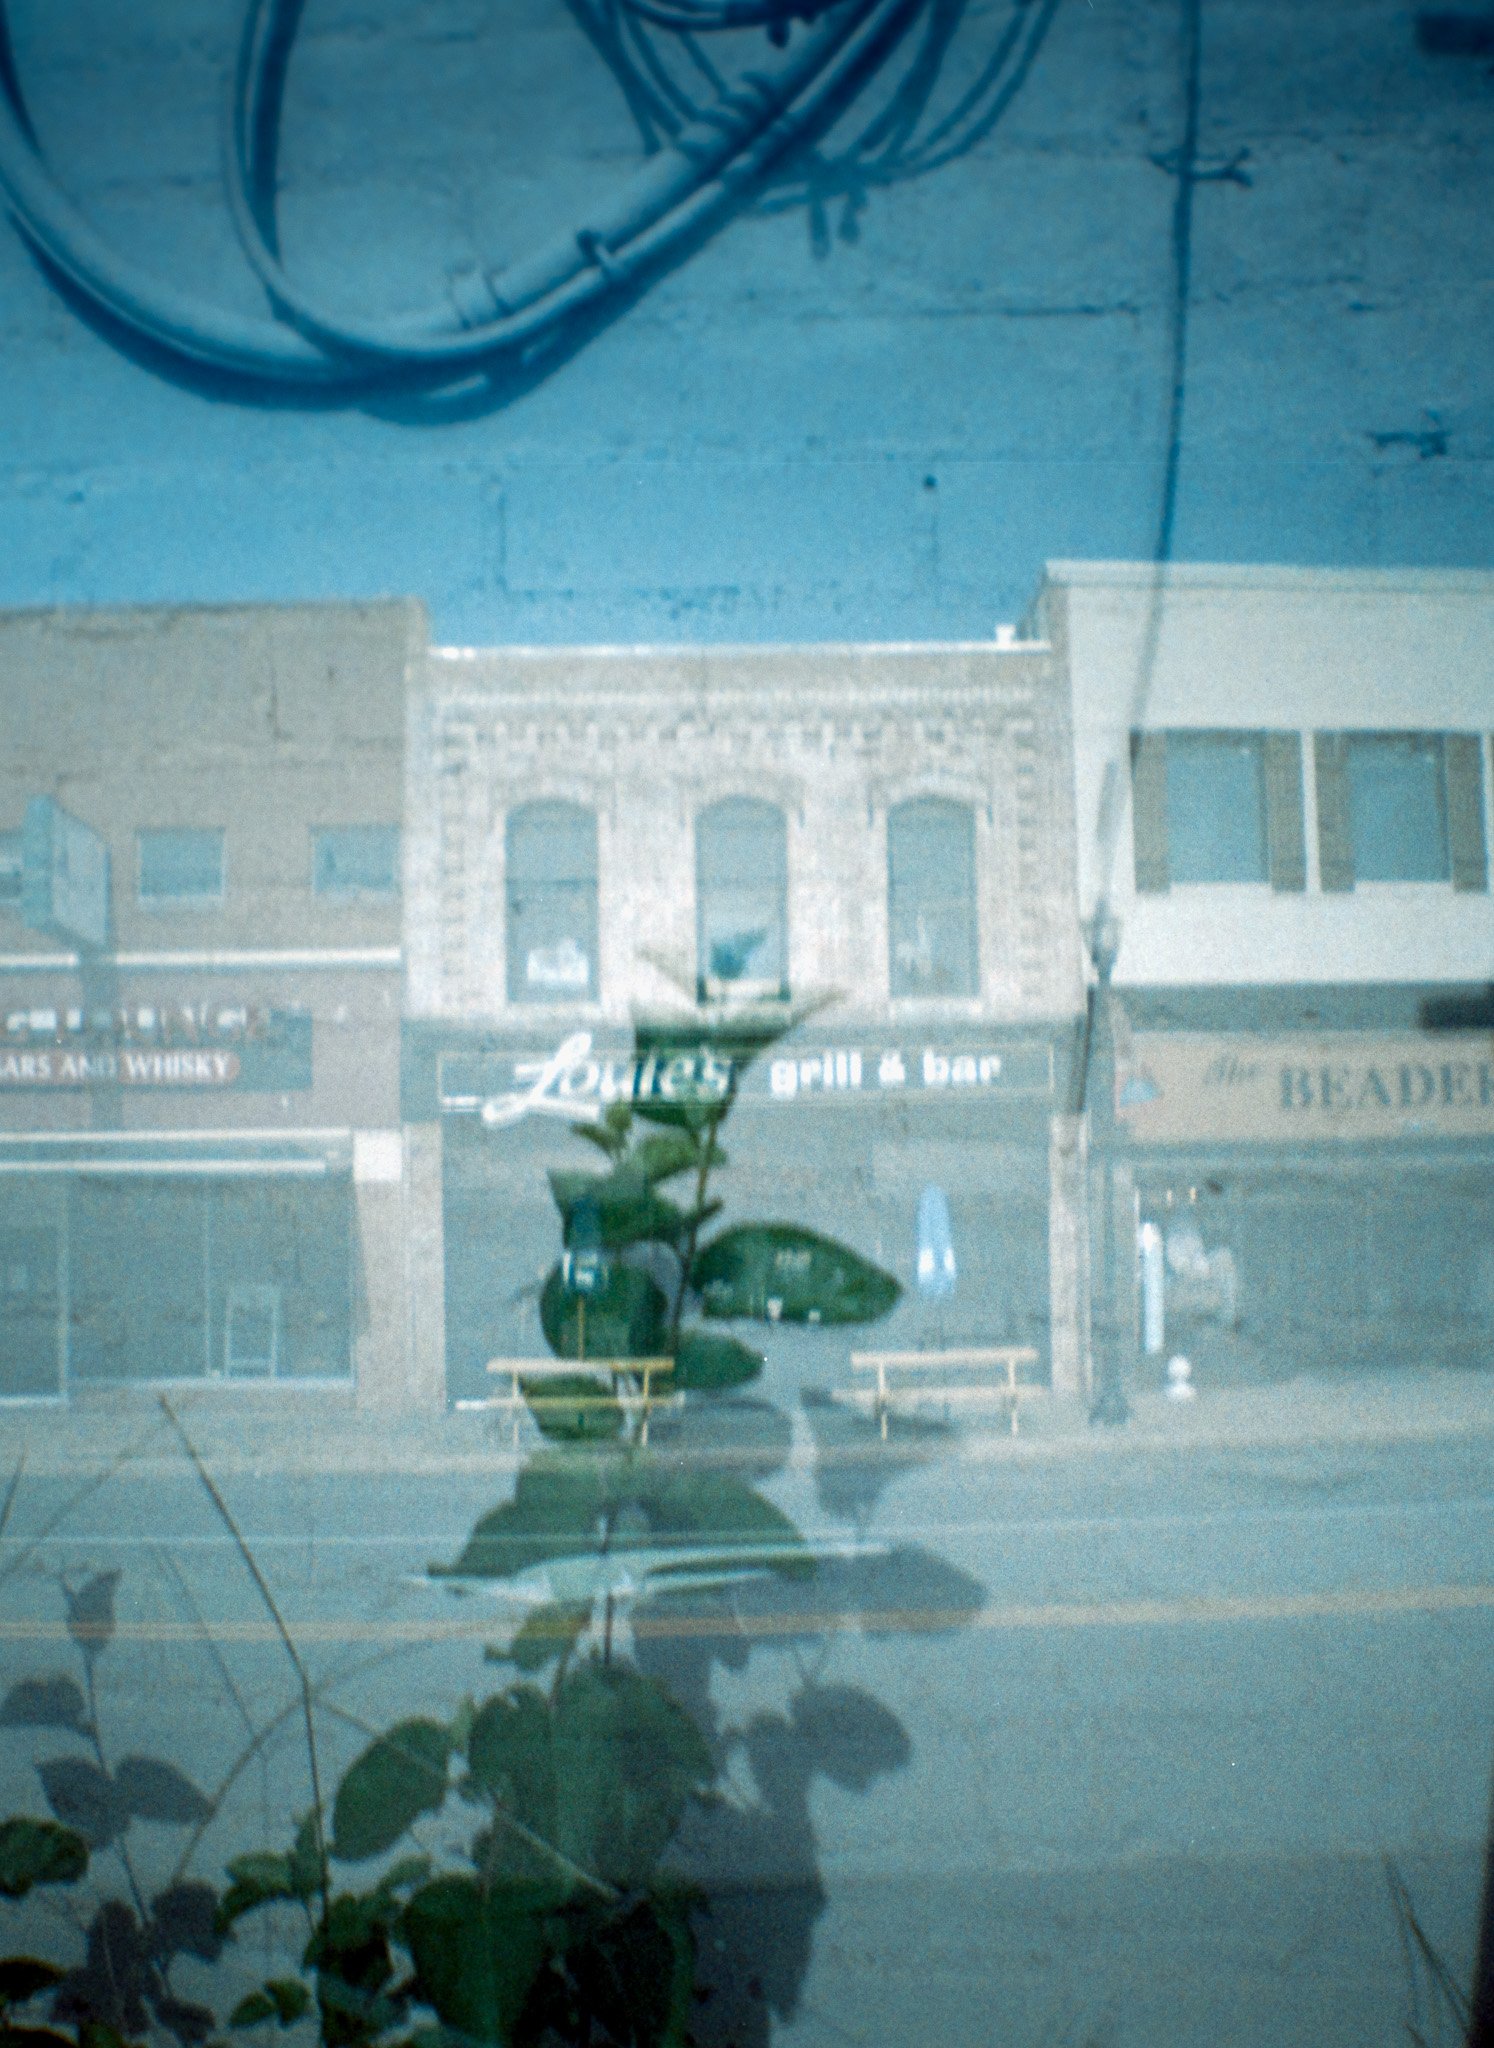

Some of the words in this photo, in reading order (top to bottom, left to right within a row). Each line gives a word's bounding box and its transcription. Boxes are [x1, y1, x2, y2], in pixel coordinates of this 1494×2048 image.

[61, 1053, 116, 1079] AND
[127, 1052, 230, 1079] WHISKY
[481, 1032, 732, 1127] Louie's
[770, 1052, 861, 1100] grill
[878, 1052, 905, 1083] &
[922, 1048, 1000, 1084] bar
